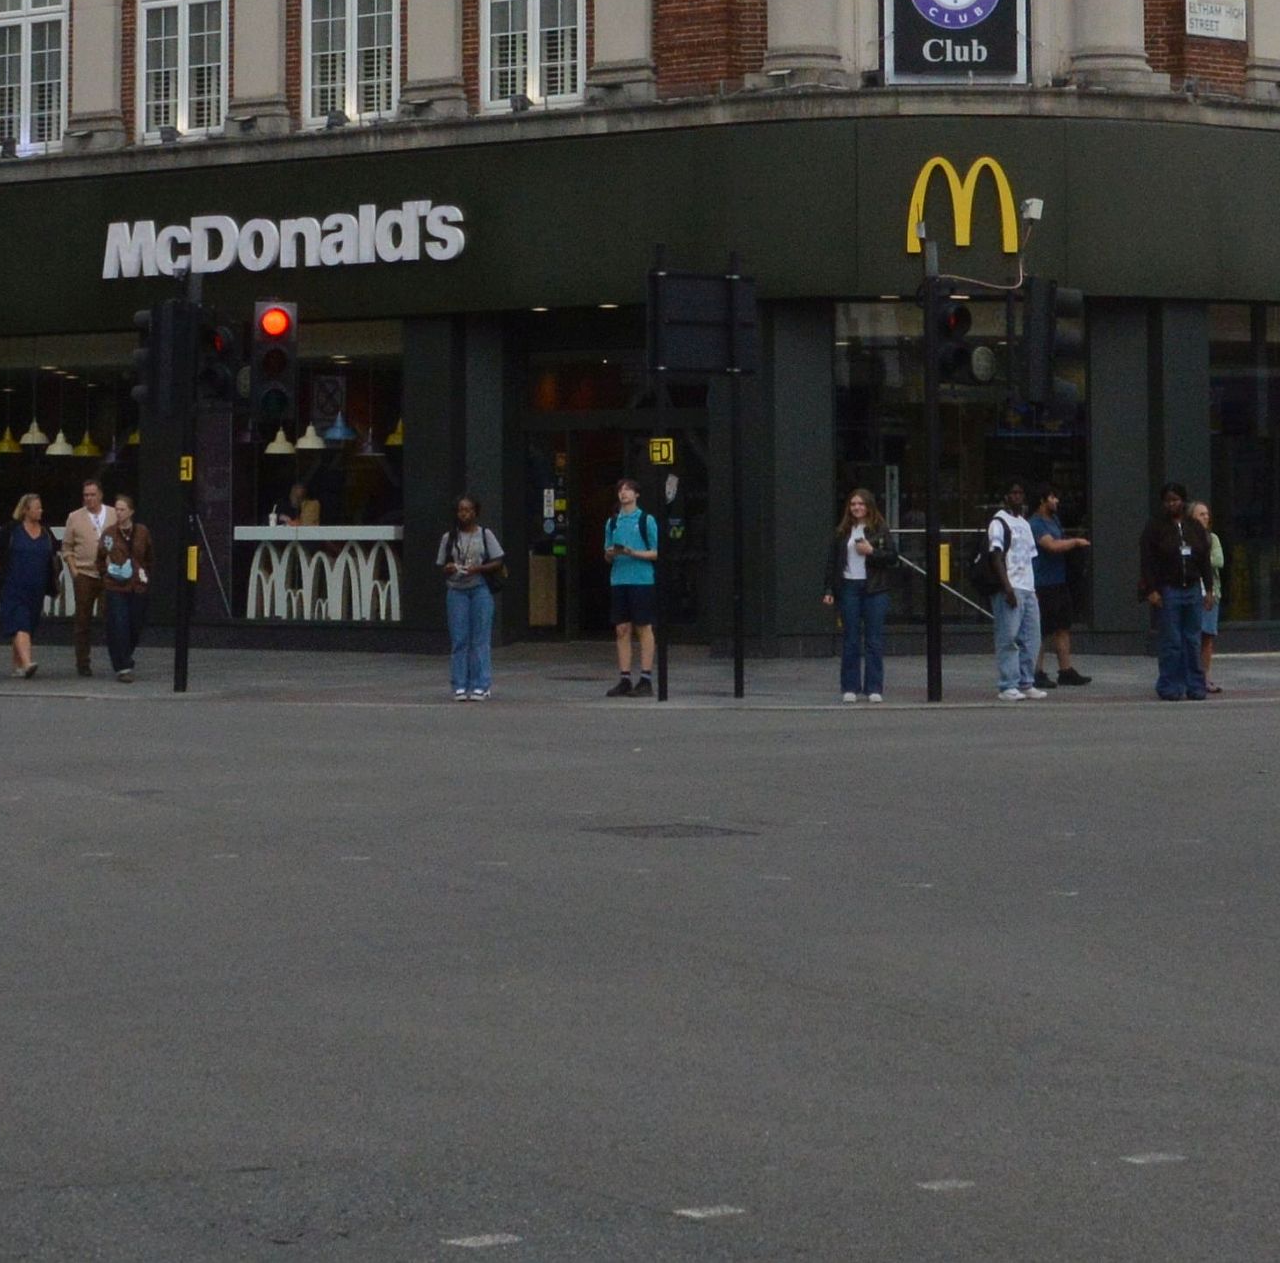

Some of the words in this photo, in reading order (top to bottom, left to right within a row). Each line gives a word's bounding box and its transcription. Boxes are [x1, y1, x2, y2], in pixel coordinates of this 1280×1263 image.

[928, 6, 984, 24] CLUB
[1189, 1, 1222, 16] ELTHAM
[1189, 18, 1220, 32] STREET
[922, 39, 988, 62] Club
[102, 199, 465, 279] McDonald's
